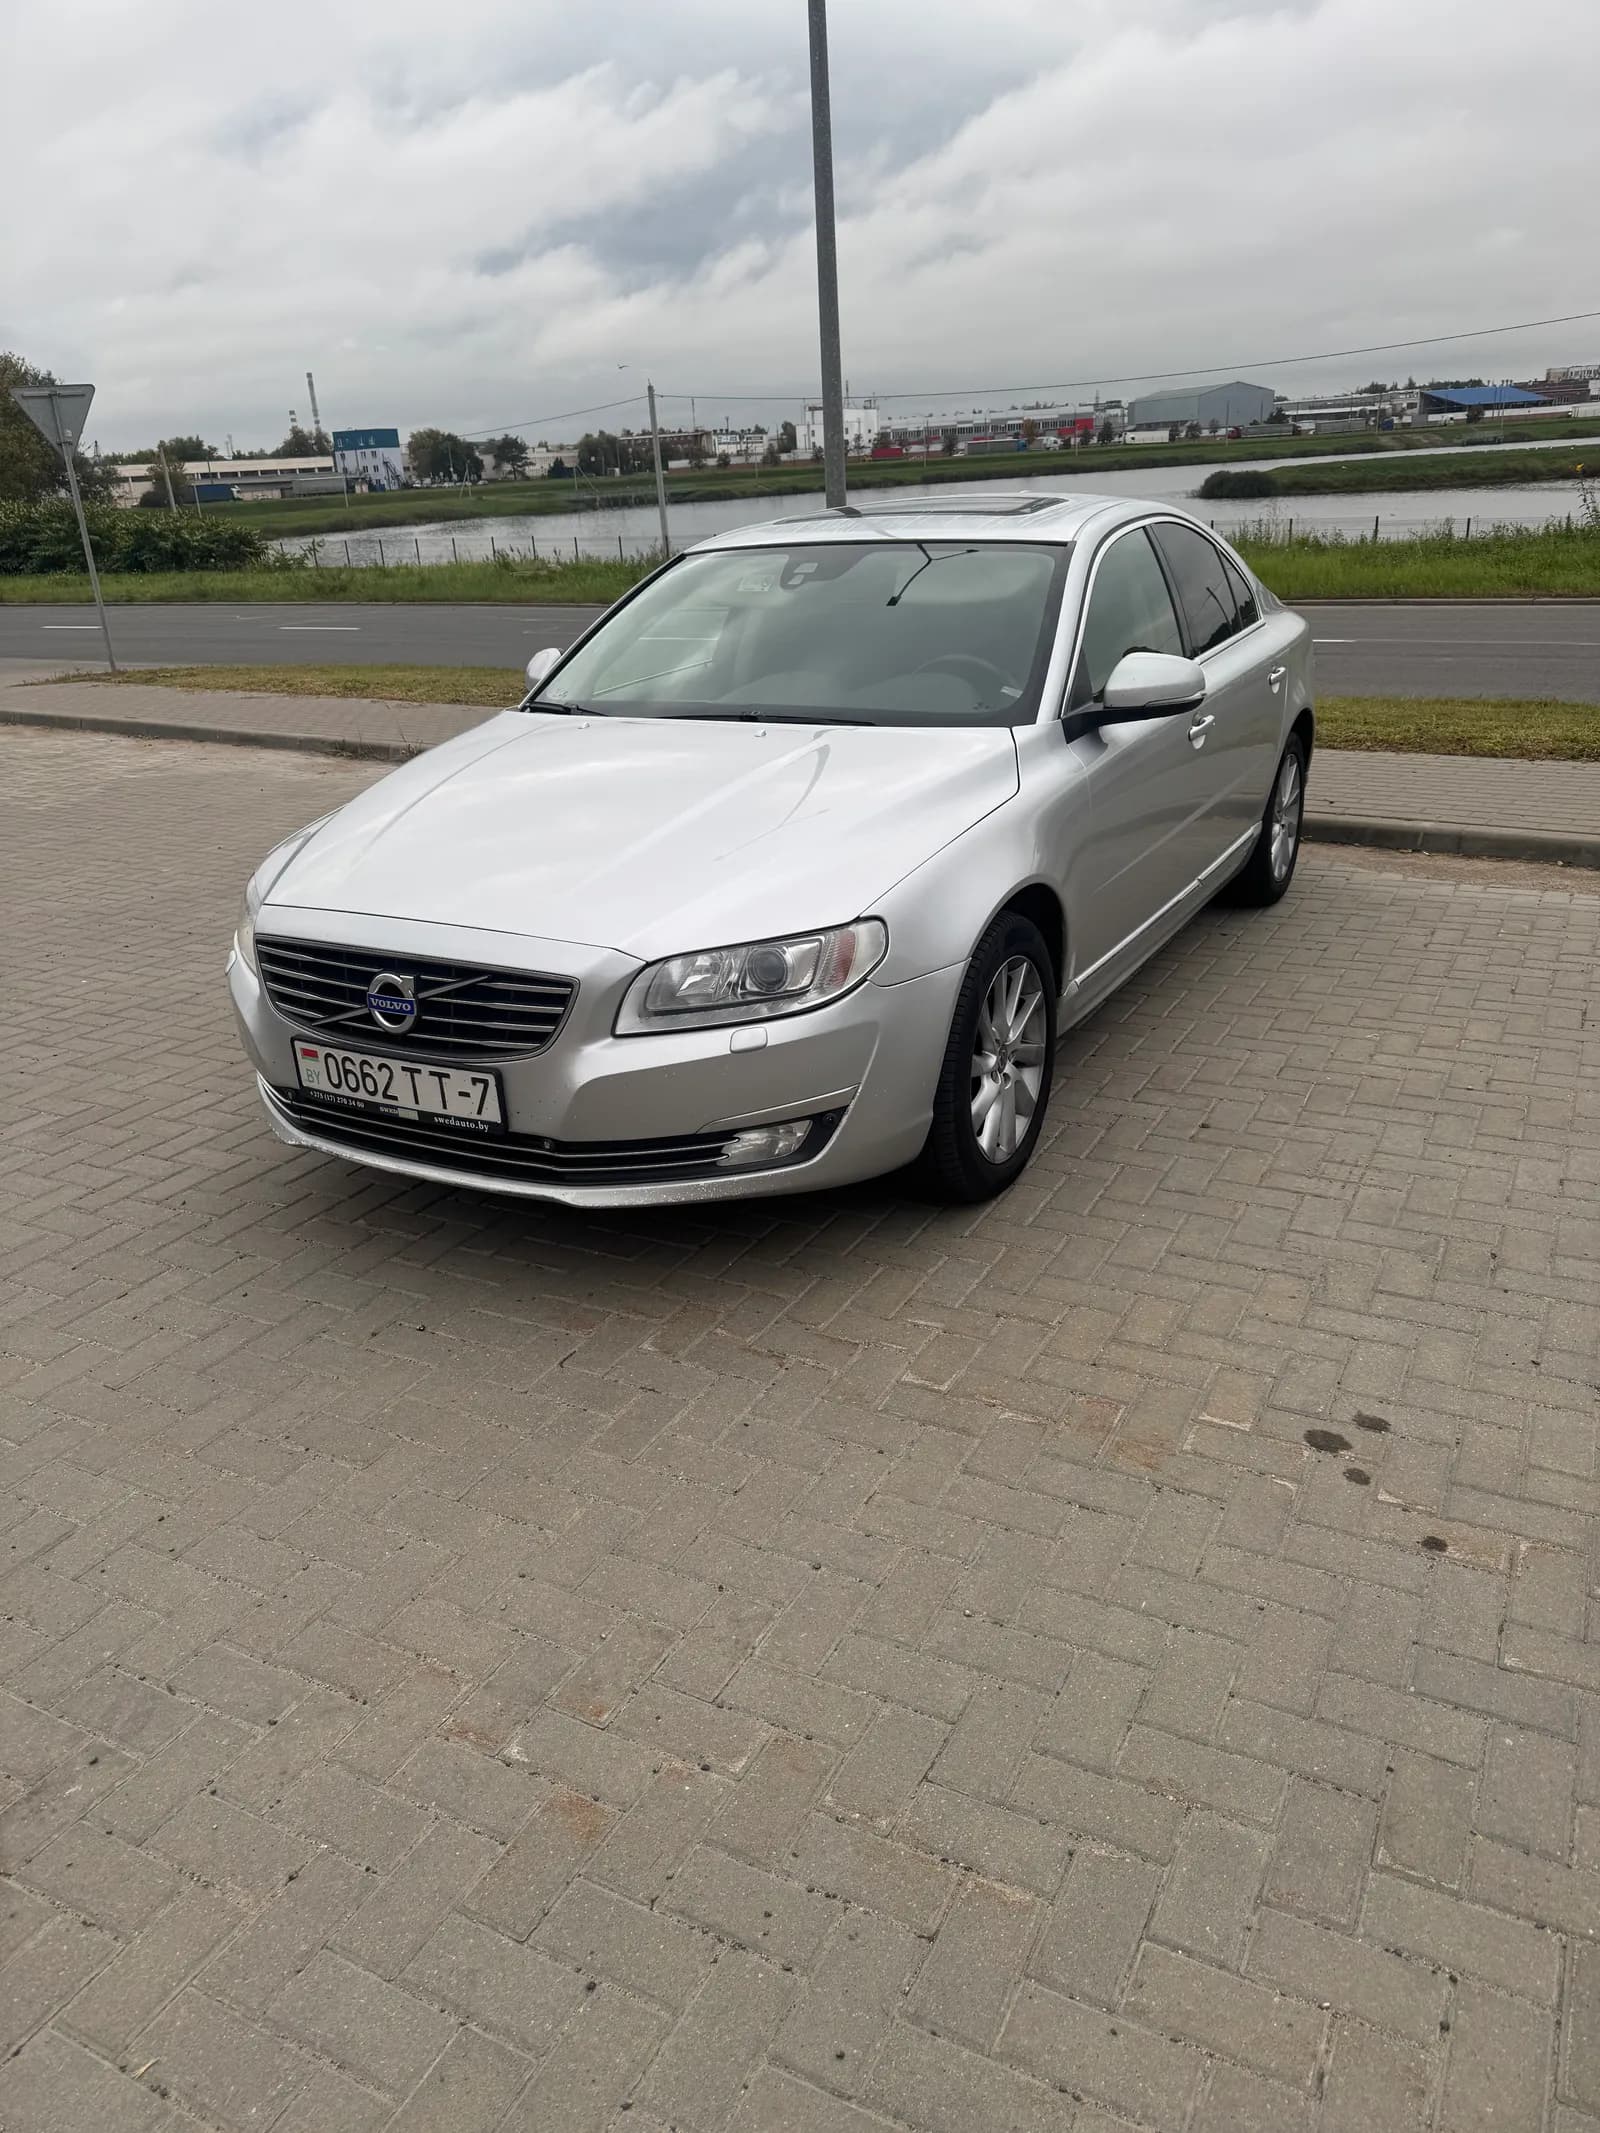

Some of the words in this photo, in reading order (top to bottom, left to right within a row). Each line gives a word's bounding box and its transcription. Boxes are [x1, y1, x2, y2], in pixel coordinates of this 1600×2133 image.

[369, 997, 411, 1011] VOLVO
[305, 1068, 320, 1085] BY
[432, 1116, 489, 1132] swedauto.by
